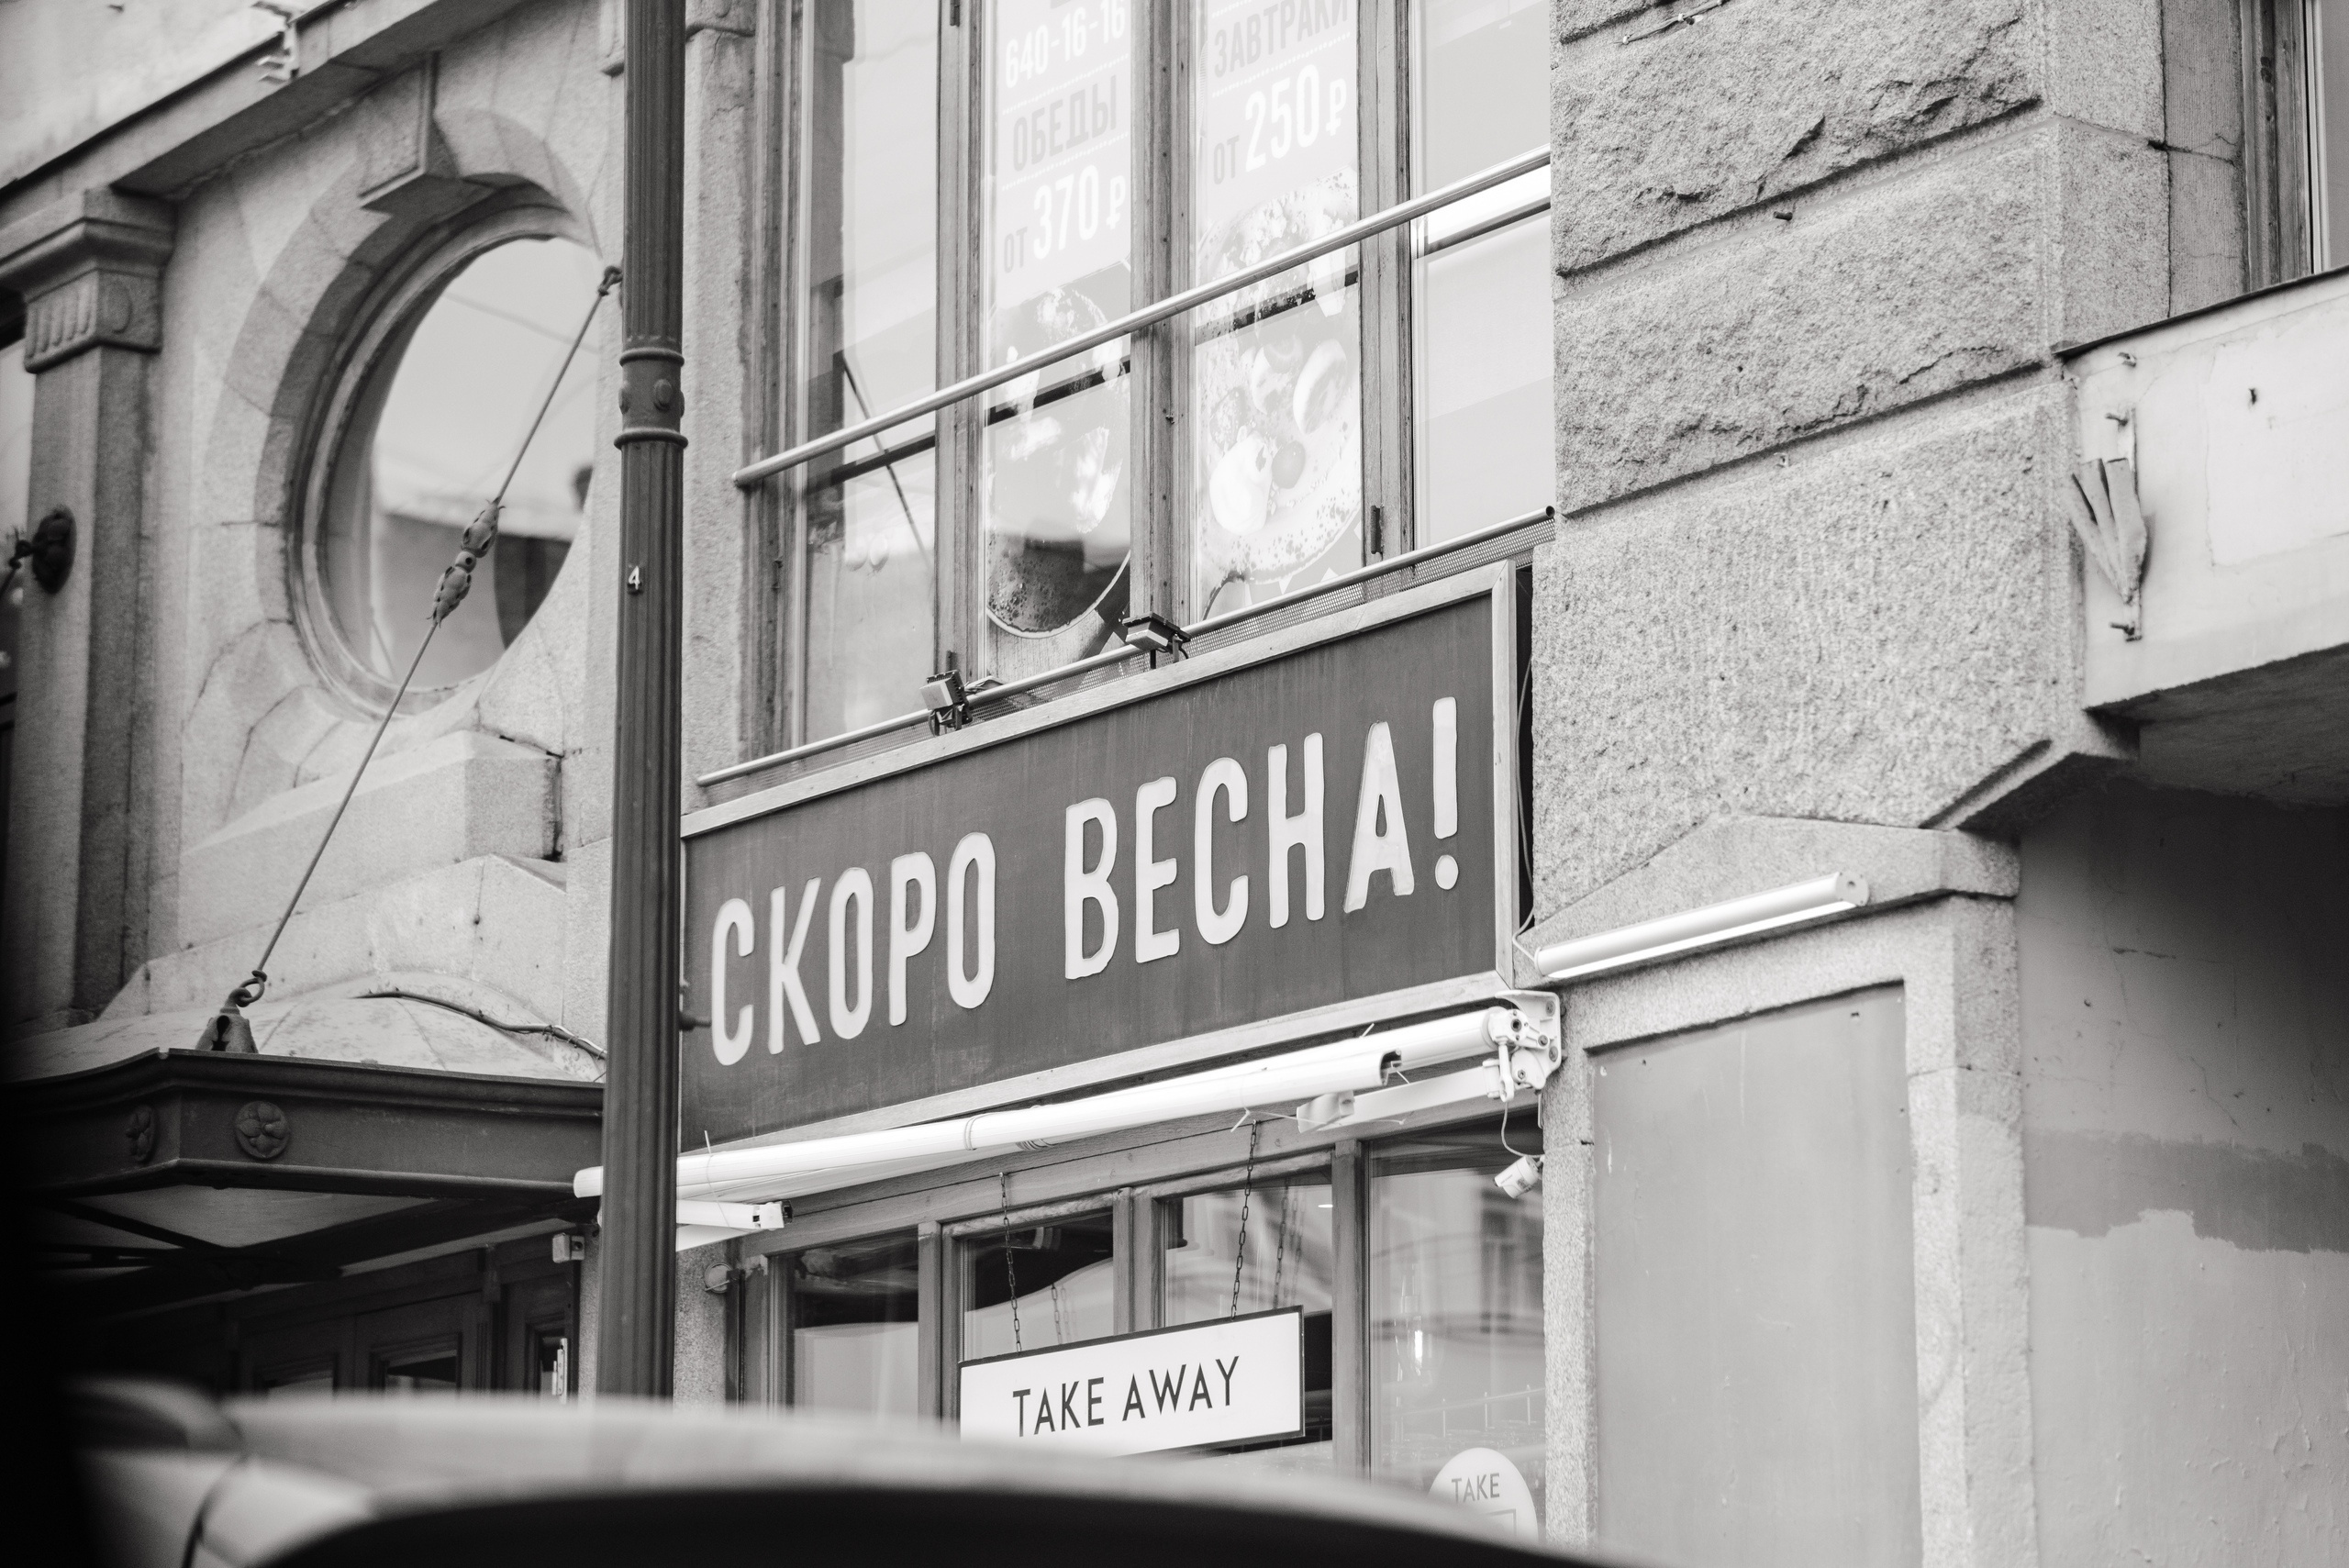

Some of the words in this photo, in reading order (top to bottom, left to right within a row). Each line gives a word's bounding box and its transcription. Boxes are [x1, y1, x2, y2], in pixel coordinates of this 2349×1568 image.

[1214, 0, 1348, 78] ЗАВТРАКИ
[1013, 74, 1117, 172] ОБЕДЫ
[711, 831, 996, 1066] СКОРО
[1064, 696, 1458, 981] ВЕСНА!
[1012, 1376, 1105, 1438] TAKE
[1121, 1355, 1240, 1421] AWAY
[1451, 1472, 1500, 1504] TAKE
